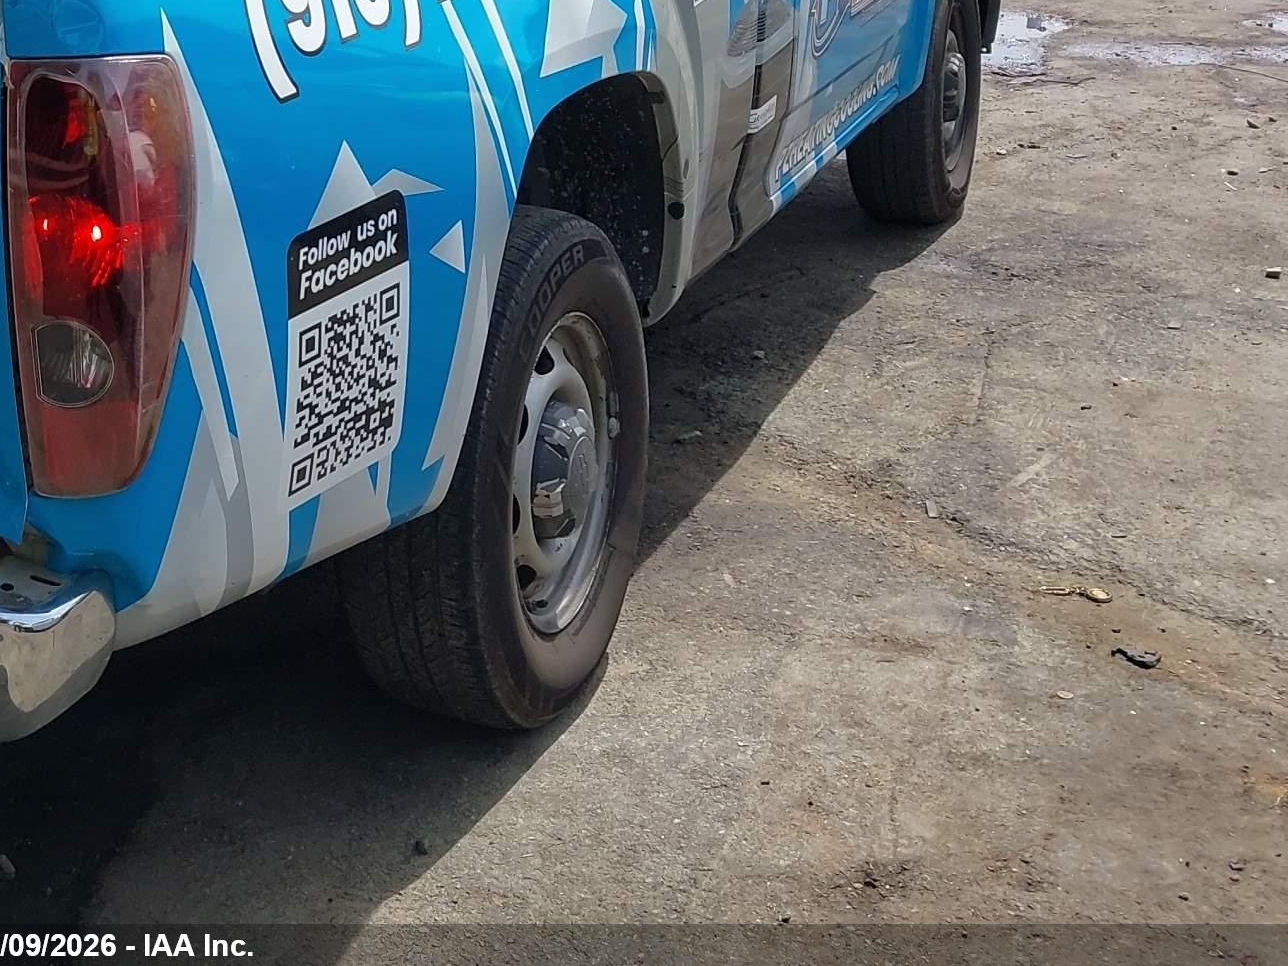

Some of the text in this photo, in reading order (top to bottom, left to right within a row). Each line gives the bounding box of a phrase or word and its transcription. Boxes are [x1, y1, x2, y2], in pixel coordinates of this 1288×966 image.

[298, 206, 398, 272] Follow us on
[298, 229, 399, 301] Facebook
[519, 243, 586, 364] COOPER
